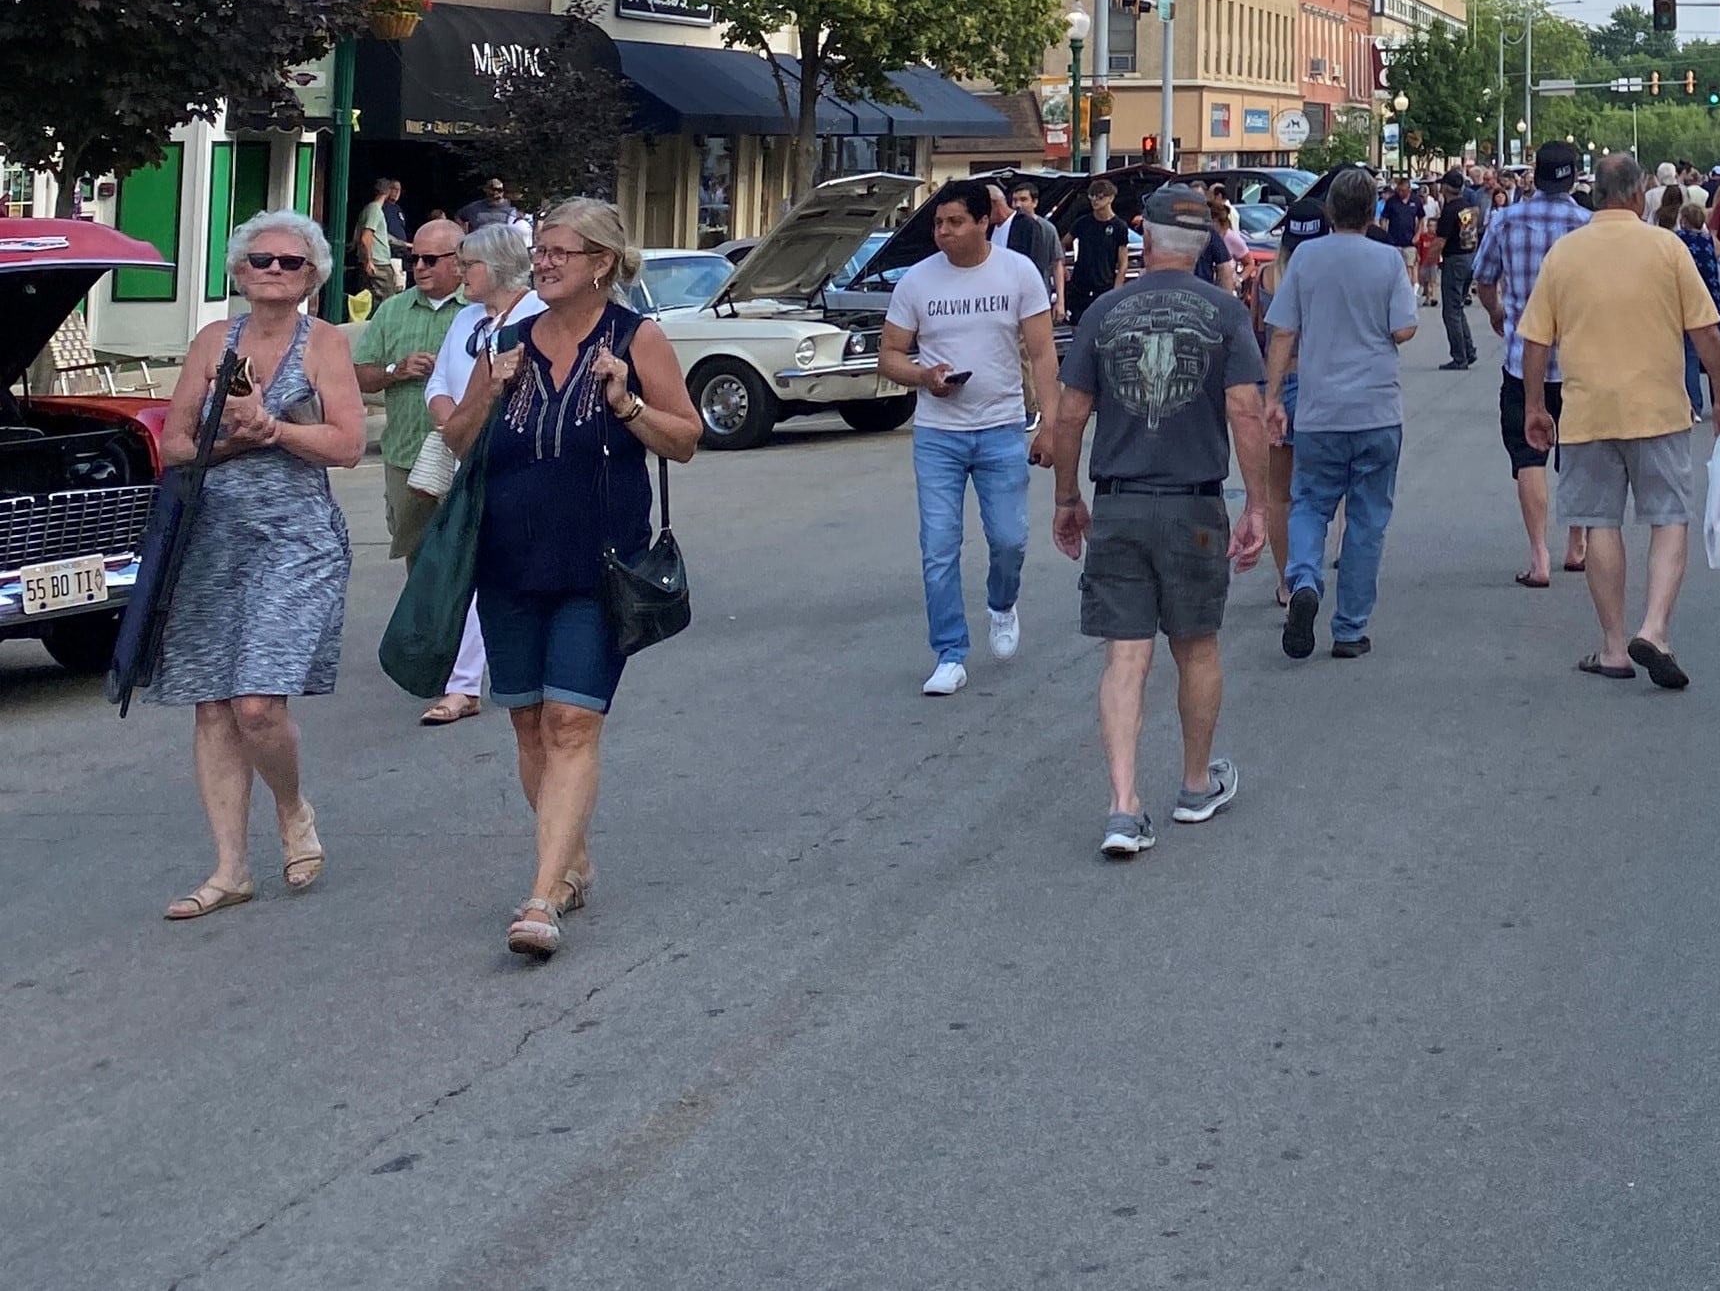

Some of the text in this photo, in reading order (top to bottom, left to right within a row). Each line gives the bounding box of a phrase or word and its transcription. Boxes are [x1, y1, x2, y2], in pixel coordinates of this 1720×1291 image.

[927, 295, 1009, 316] CALVIN KLEIN
[26, 578, 46, 601] 55
[74, 570, 93, 594] TI
